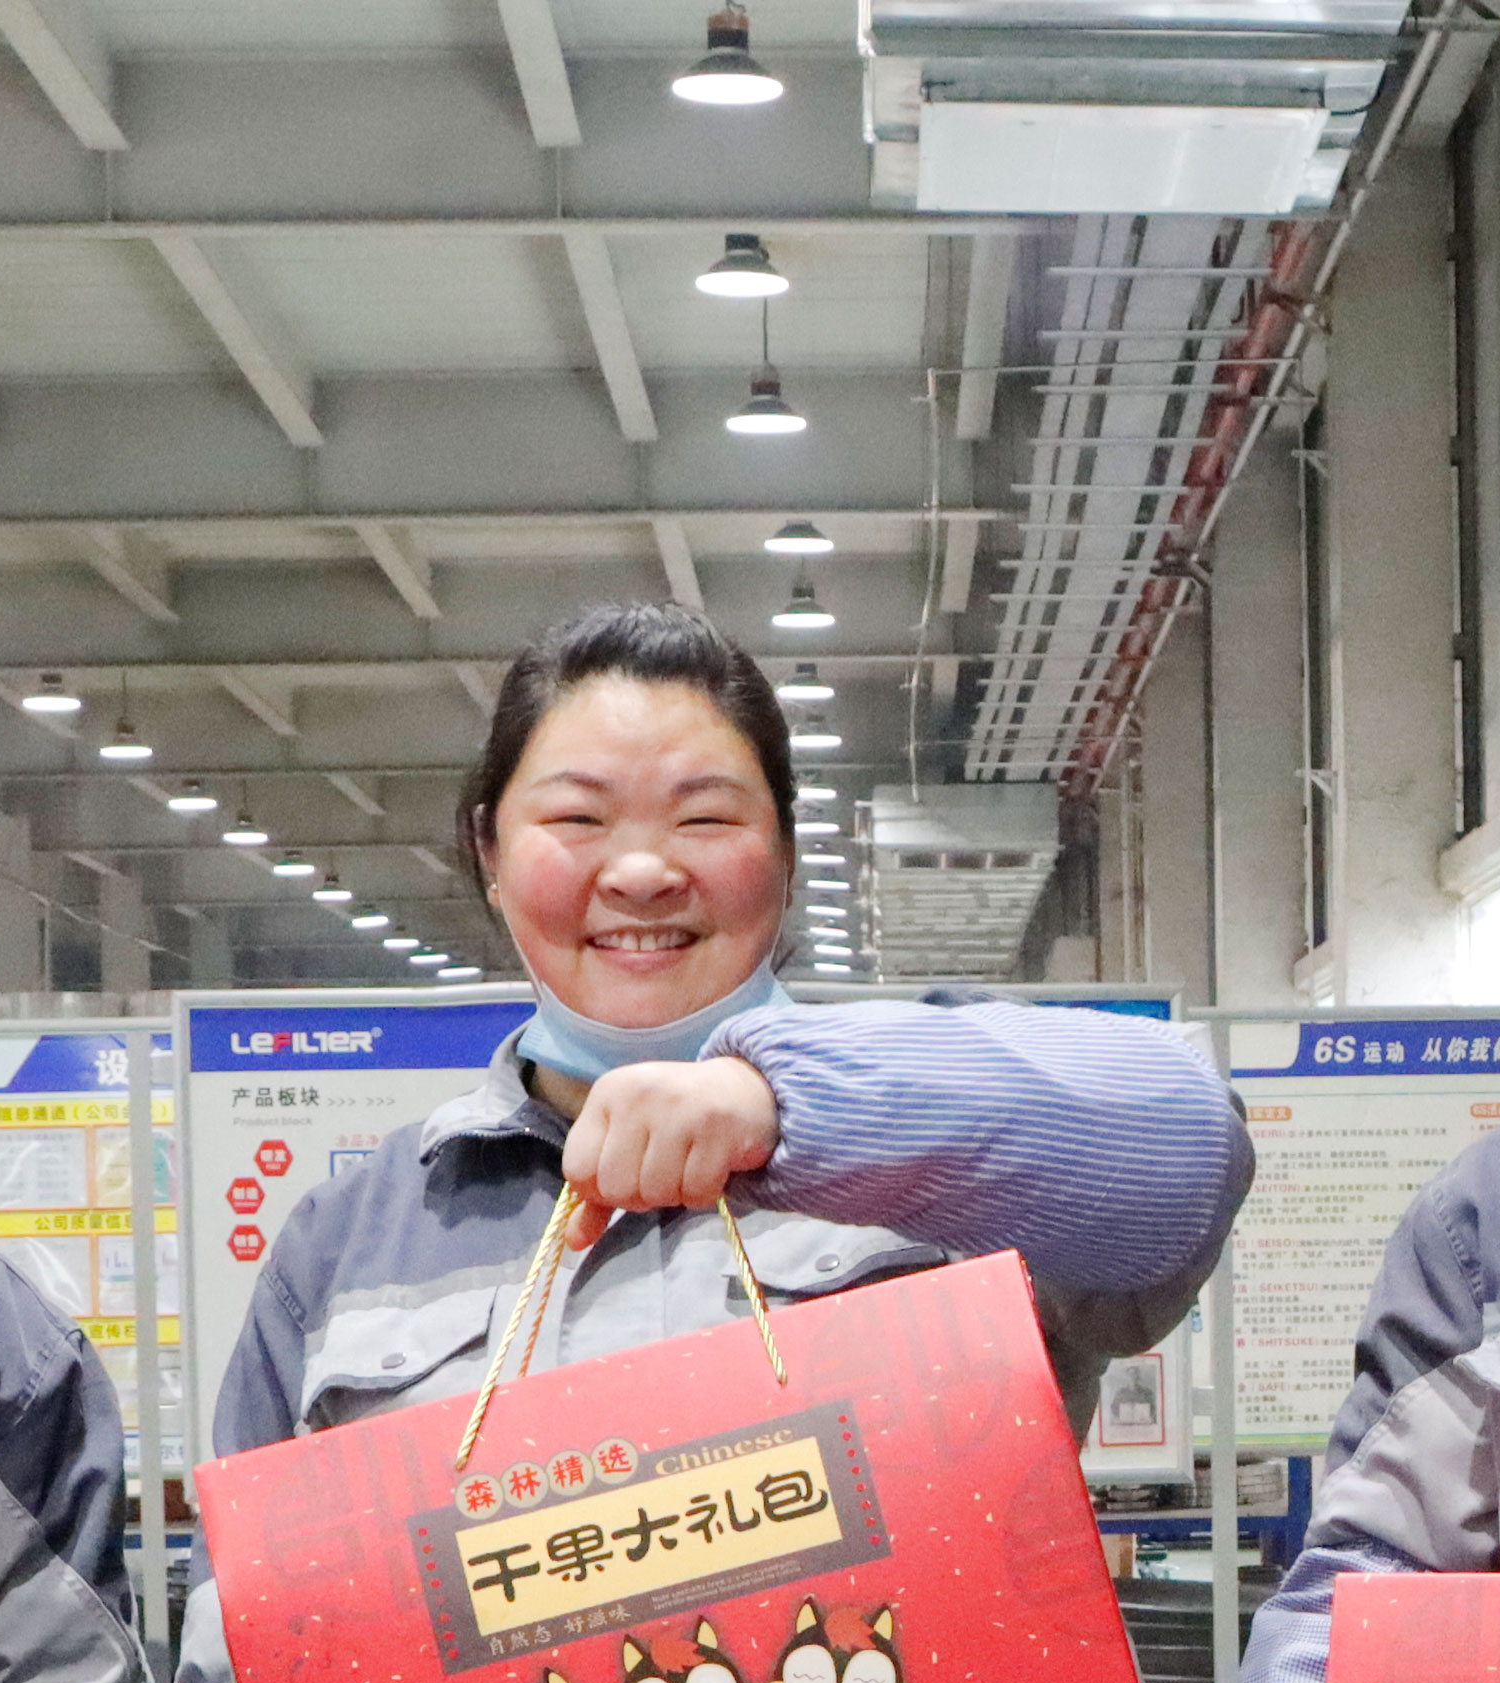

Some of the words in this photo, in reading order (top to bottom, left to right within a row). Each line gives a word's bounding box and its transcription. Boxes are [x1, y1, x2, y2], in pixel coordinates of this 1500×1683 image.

[1313, 1035, 1356, 1064] 6S
[1363, 1041, 1405, 1064] 运动
[232, 1086, 320, 1108] 产品板块
[654, 1426, 795, 1477] Chinese
[464, 1444, 632, 1512] 森林精选
[467, 1470, 830, 1603] 干果大礼包
[563, 1603, 632, 1634] 好滋味
